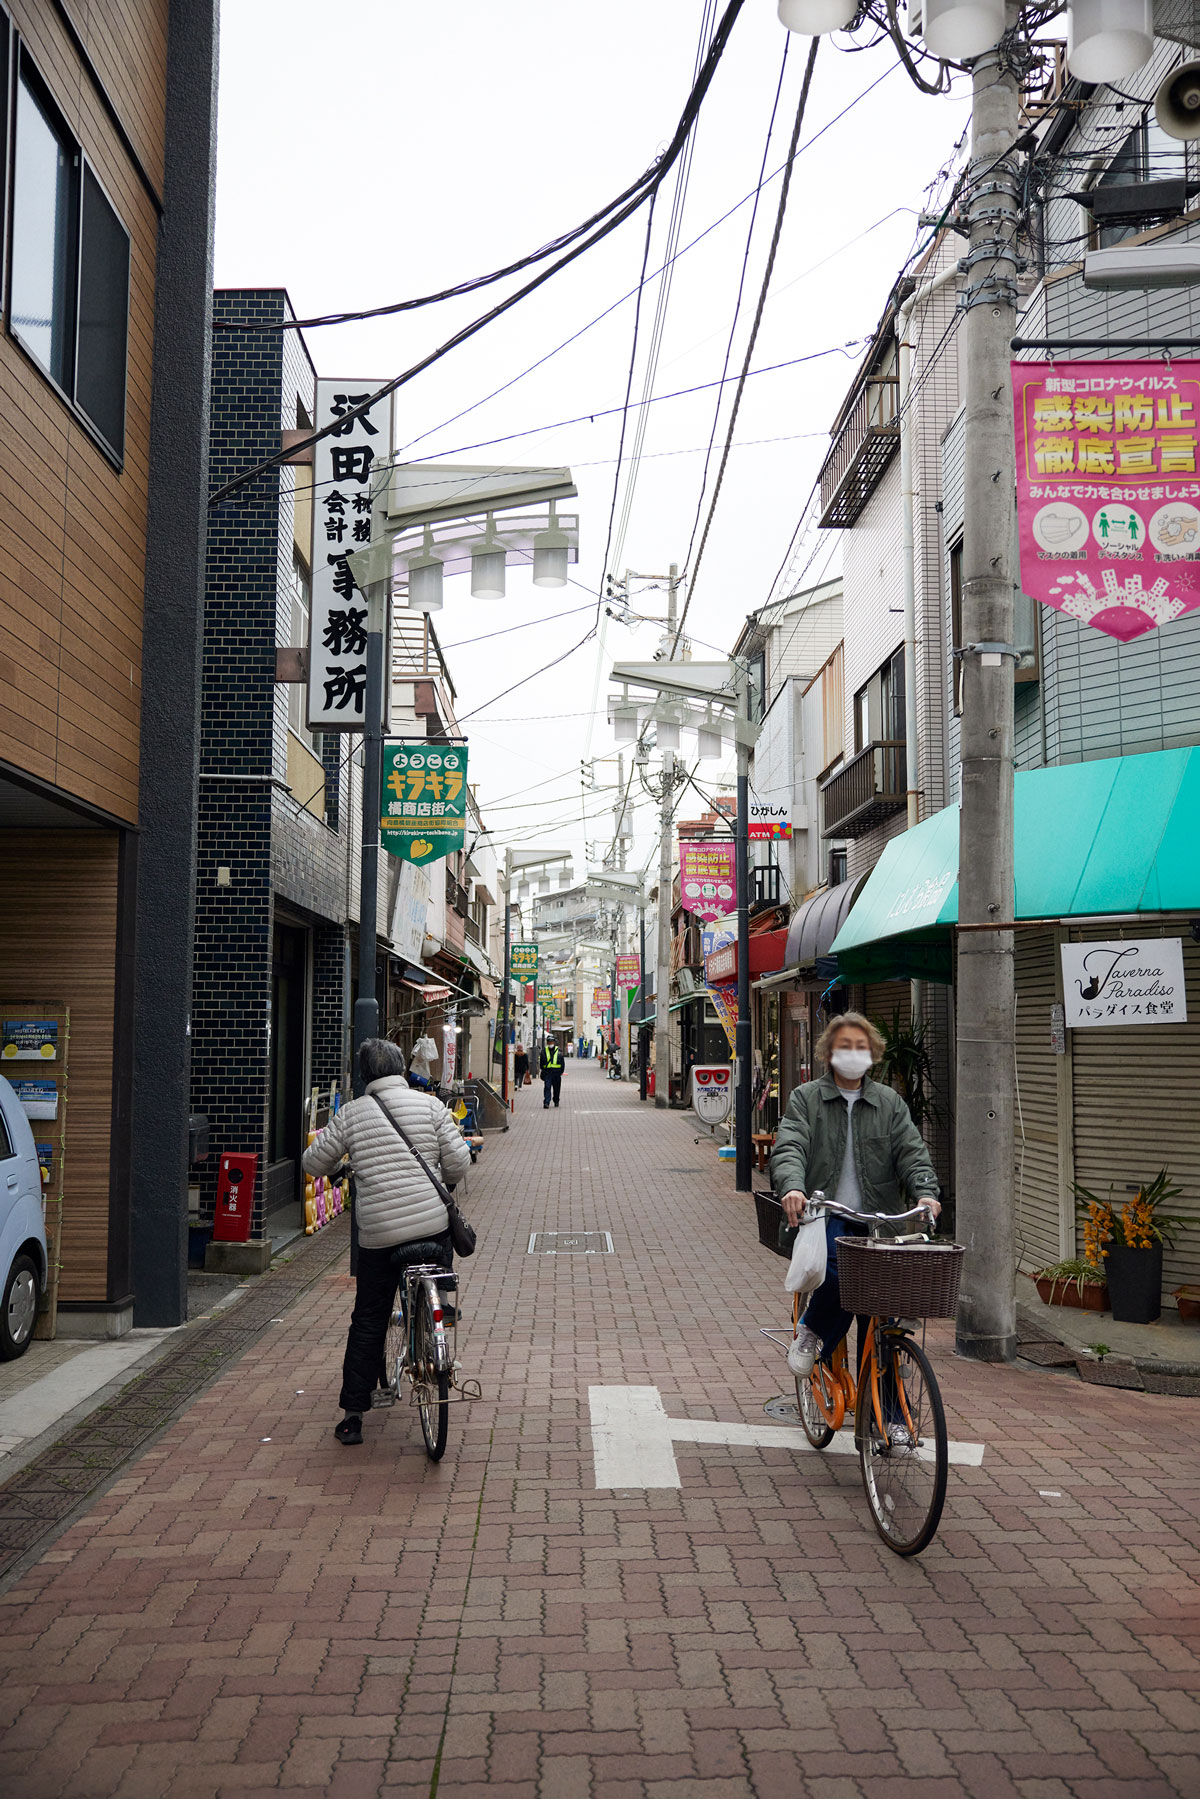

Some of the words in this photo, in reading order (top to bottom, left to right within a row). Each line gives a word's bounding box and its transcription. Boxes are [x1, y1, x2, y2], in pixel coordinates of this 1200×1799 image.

[1045, 377, 1177, 393] 新型コロナウイルス
[1033, 394, 1197, 433] 感染防止
[329, 393, 380, 484] 沢田
[1034, 435, 1198, 475] 徹底宣言
[322, 490, 351, 544] 会計
[1037, 550, 1088, 561] マスクの着用
[1098, 550, 1145, 562] ディスタンス
[1102, 541, 1140, 551] ソーシャル
[322, 548, 369, 714] 事務所
[393, 753, 460, 769] ようこそ
[387, 770, 463, 800] キラキラ
[388, 801, 460, 817] 橘商店街へ
[750, 806, 788, 816] ひがしん
[512, 953, 537, 963] キラキラ
[1083, 947, 1164, 998] Taverna
[1103, 979, 1174, 1000] Paradiso
[1079, 1000, 1174, 1019] パラダイス食堂
[229, 1186, 238, 1212] 消火器
